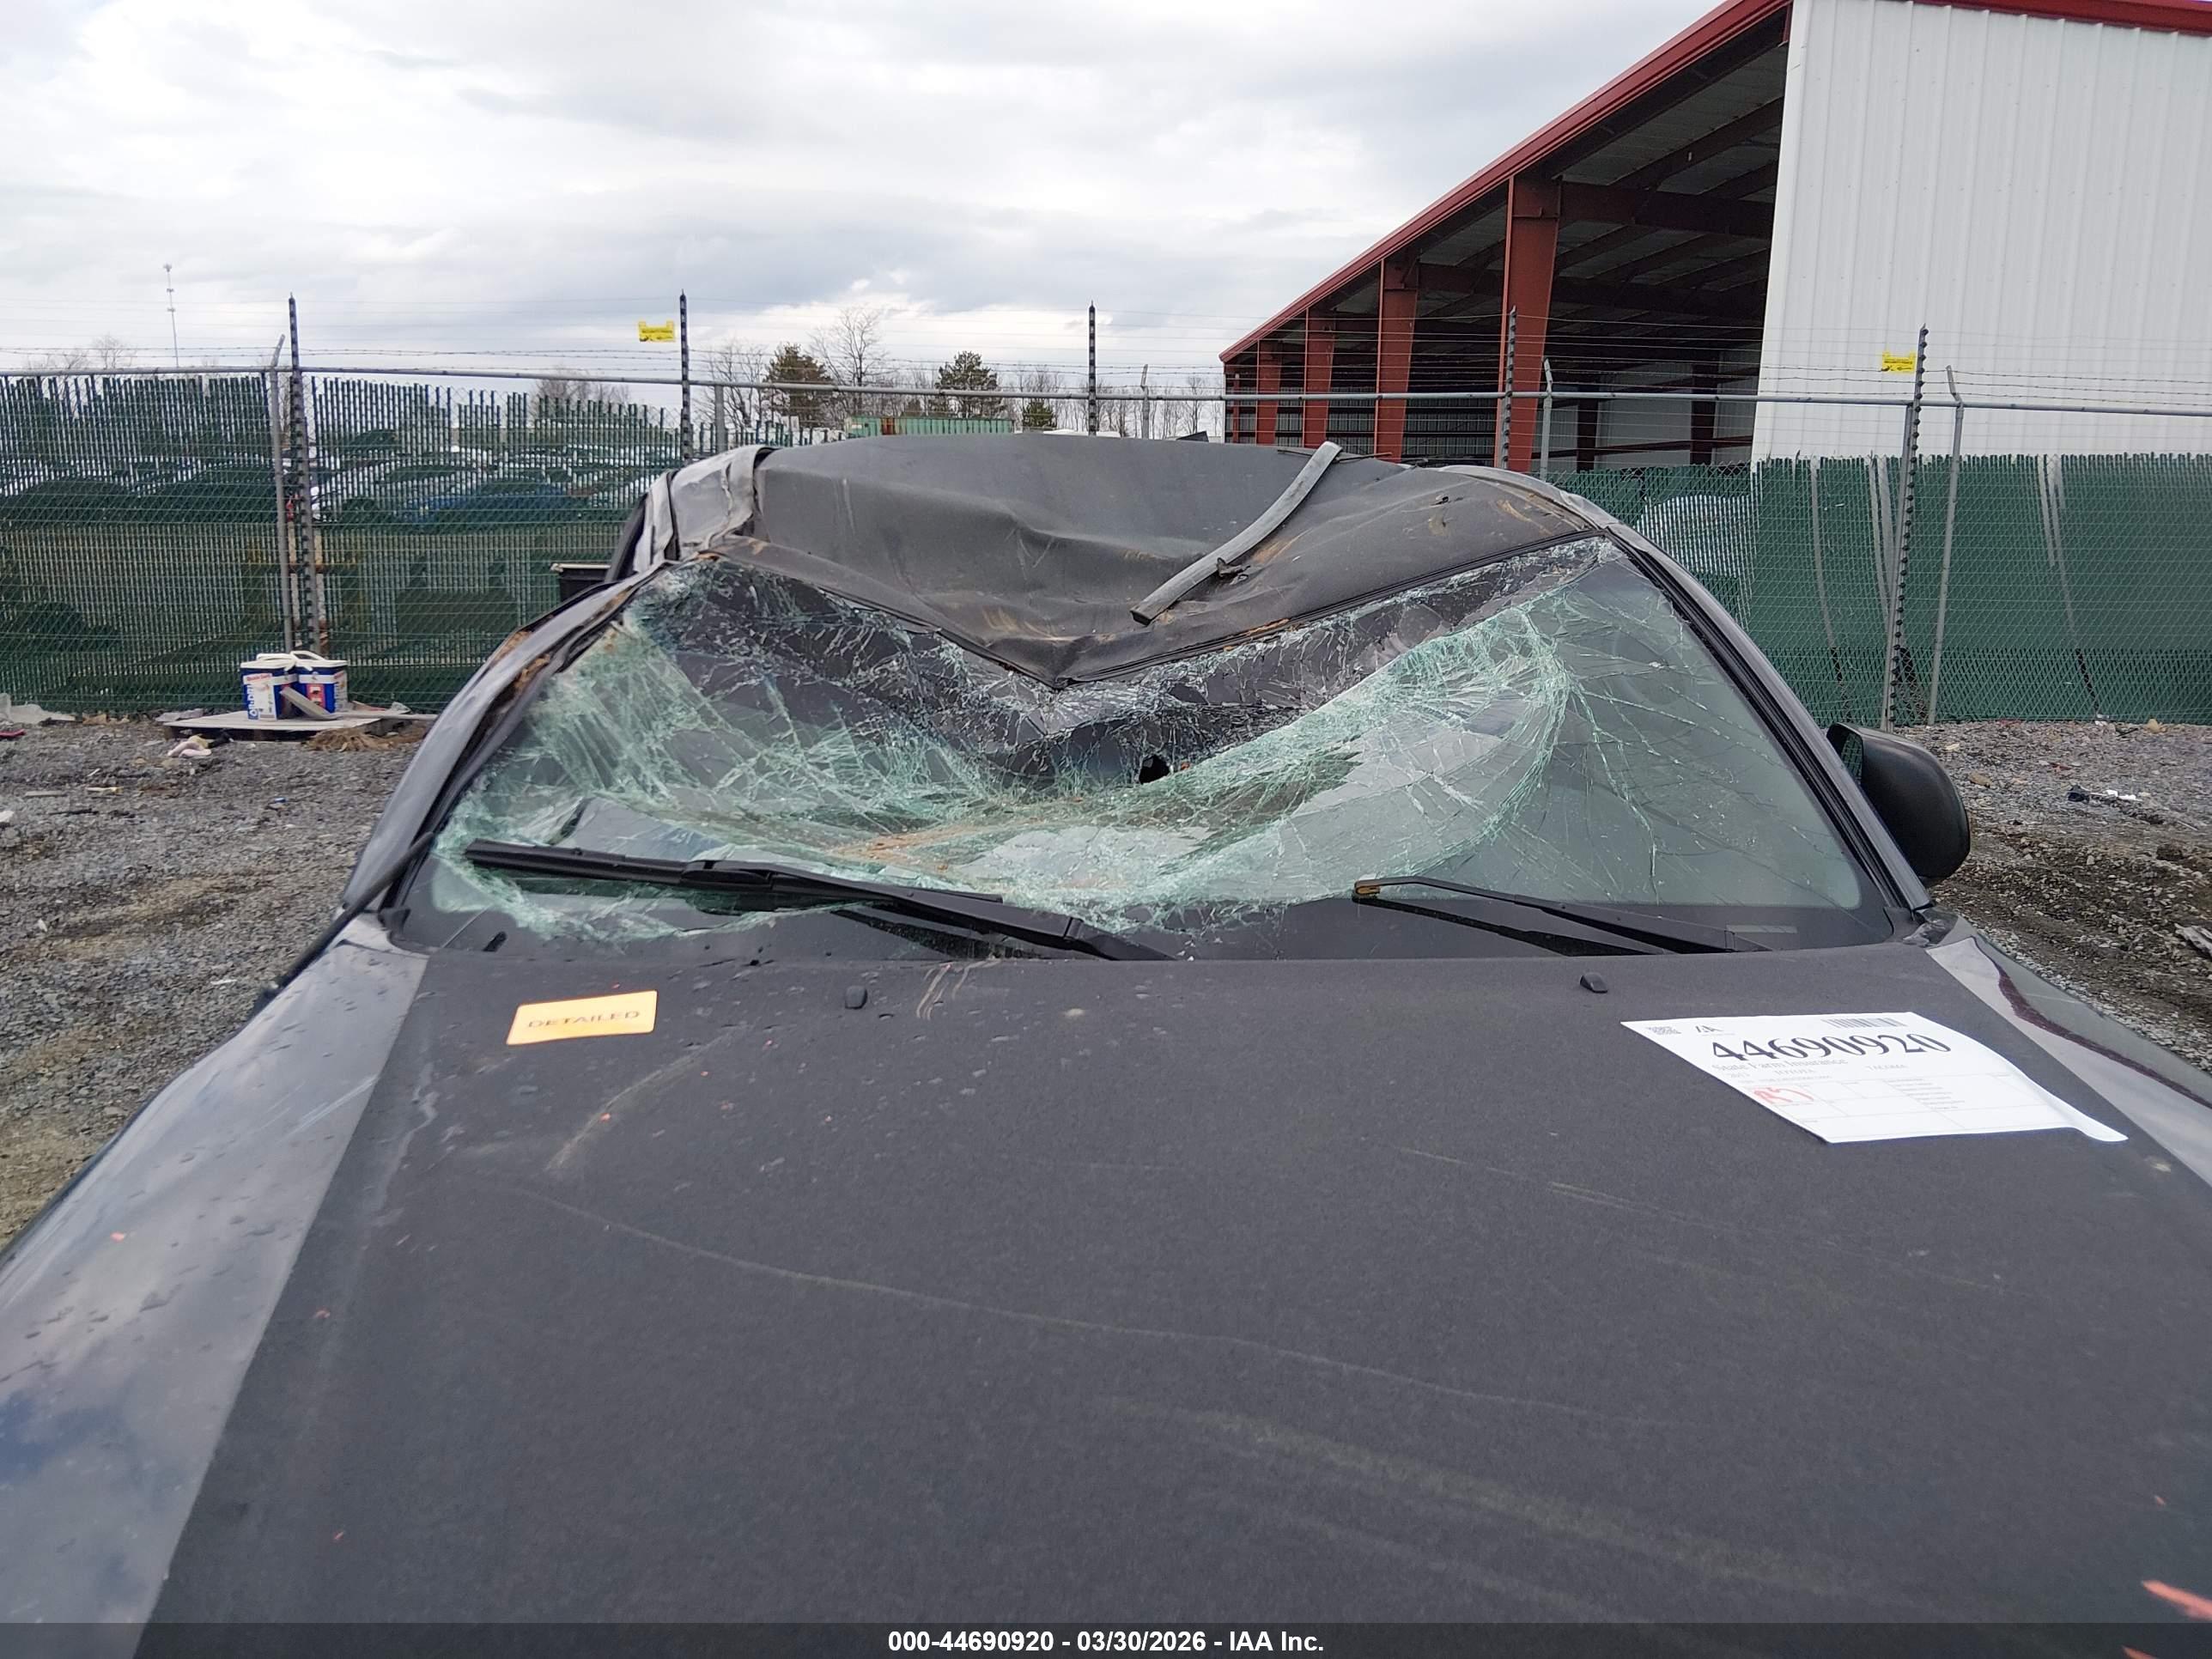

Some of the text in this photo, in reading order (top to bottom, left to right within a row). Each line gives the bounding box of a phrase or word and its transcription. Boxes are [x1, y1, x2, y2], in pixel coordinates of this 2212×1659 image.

[528, 1010, 641, 1028] DETAILED
[1712, 1033, 1952, 1061] 44690920
[1784, 1059, 1848, 1067] Insurance
